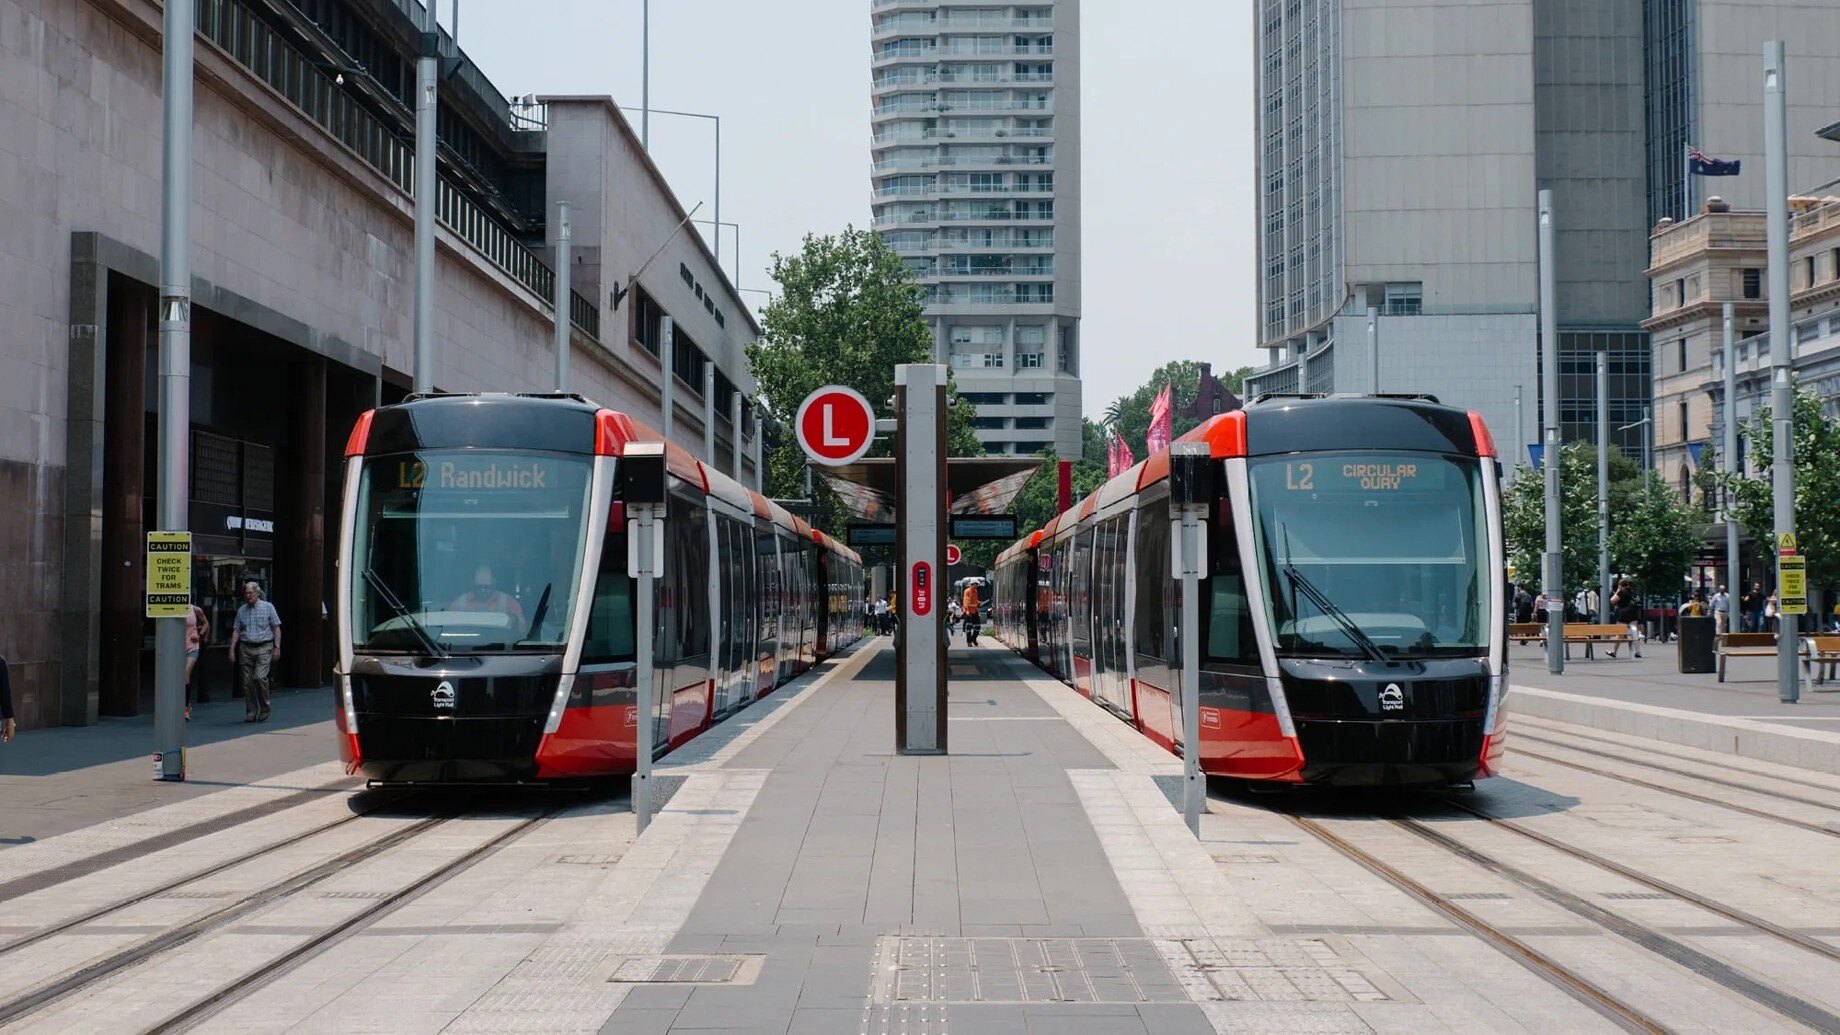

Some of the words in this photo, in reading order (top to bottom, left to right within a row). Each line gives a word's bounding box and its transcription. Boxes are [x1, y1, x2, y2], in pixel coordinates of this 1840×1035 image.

[823, 403, 850, 446] L
[399, 461, 426, 488] L2
[440, 461, 546, 489] Randwick
[1286, 463, 1314, 490] L2
[1342, 464, 1417, 477] CIRCULAR
[149, 595, 188, 603] CAUTION
